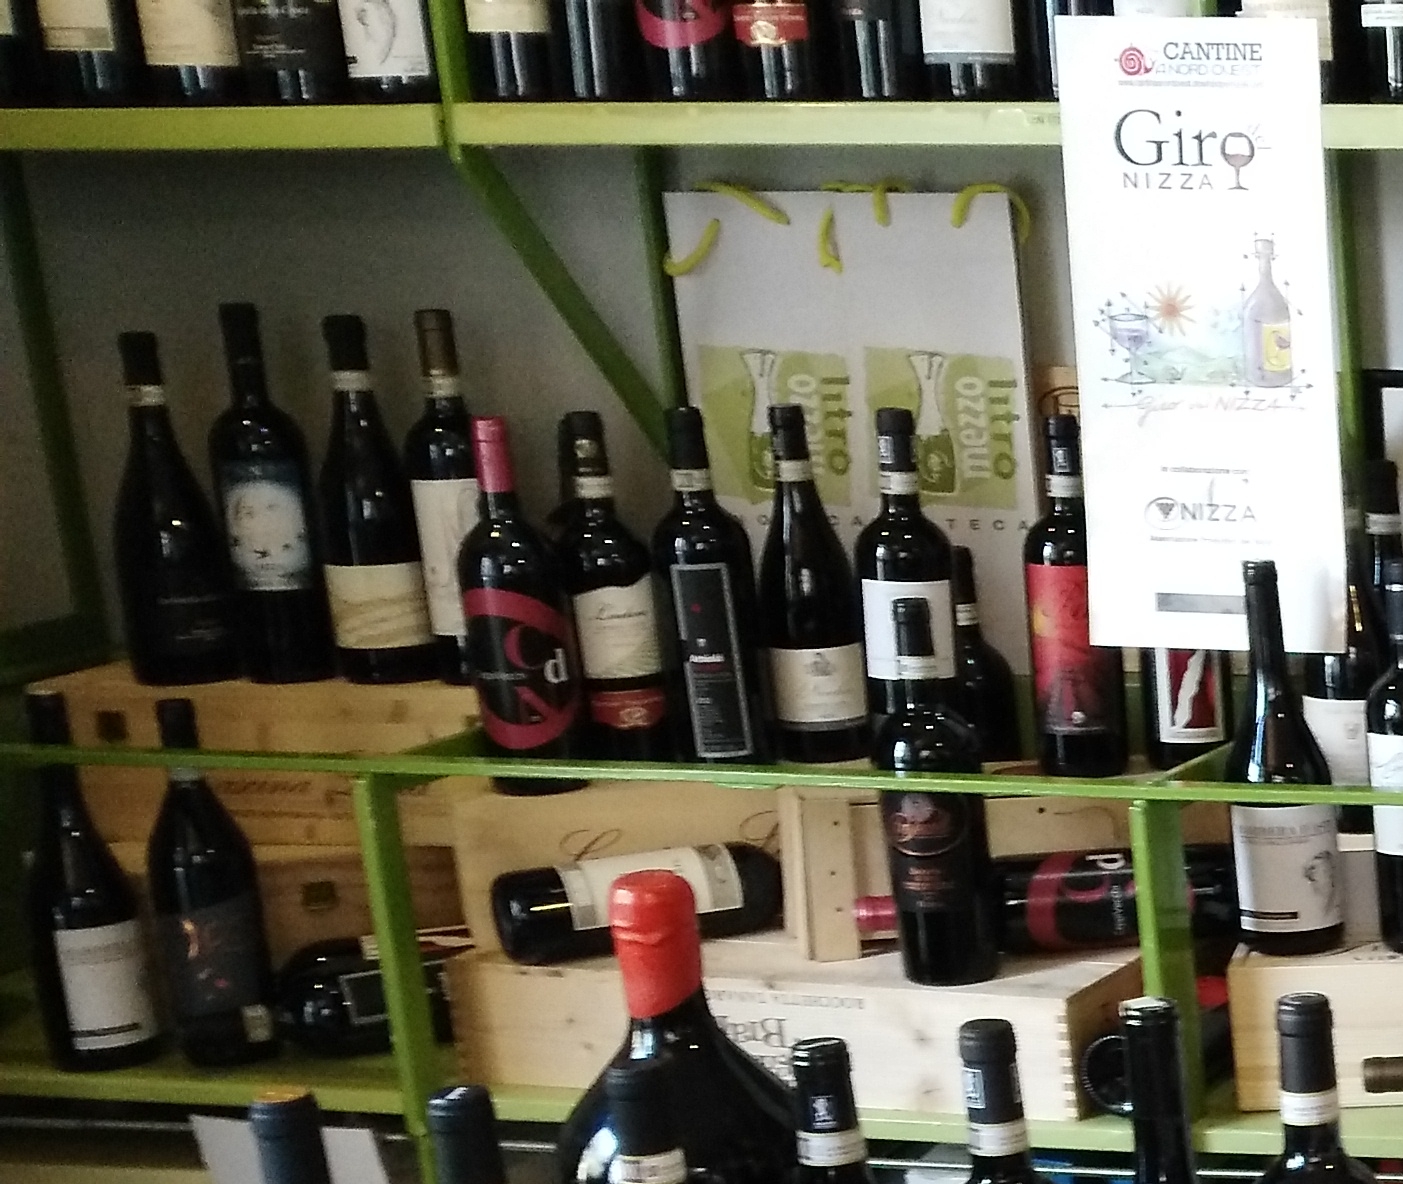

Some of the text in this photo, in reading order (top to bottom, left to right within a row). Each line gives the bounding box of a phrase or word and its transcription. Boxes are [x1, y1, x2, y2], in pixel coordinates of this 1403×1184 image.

[1163, 42, 1263, 62] CANTINE
[1114, 109, 1256, 191] Giro
[1123, 172, 1213, 190] NIZZA
[954, 376, 991, 480] mezzo
[988, 379, 1019, 480] litro
[1180, 502, 1257, 523] NIZZA
